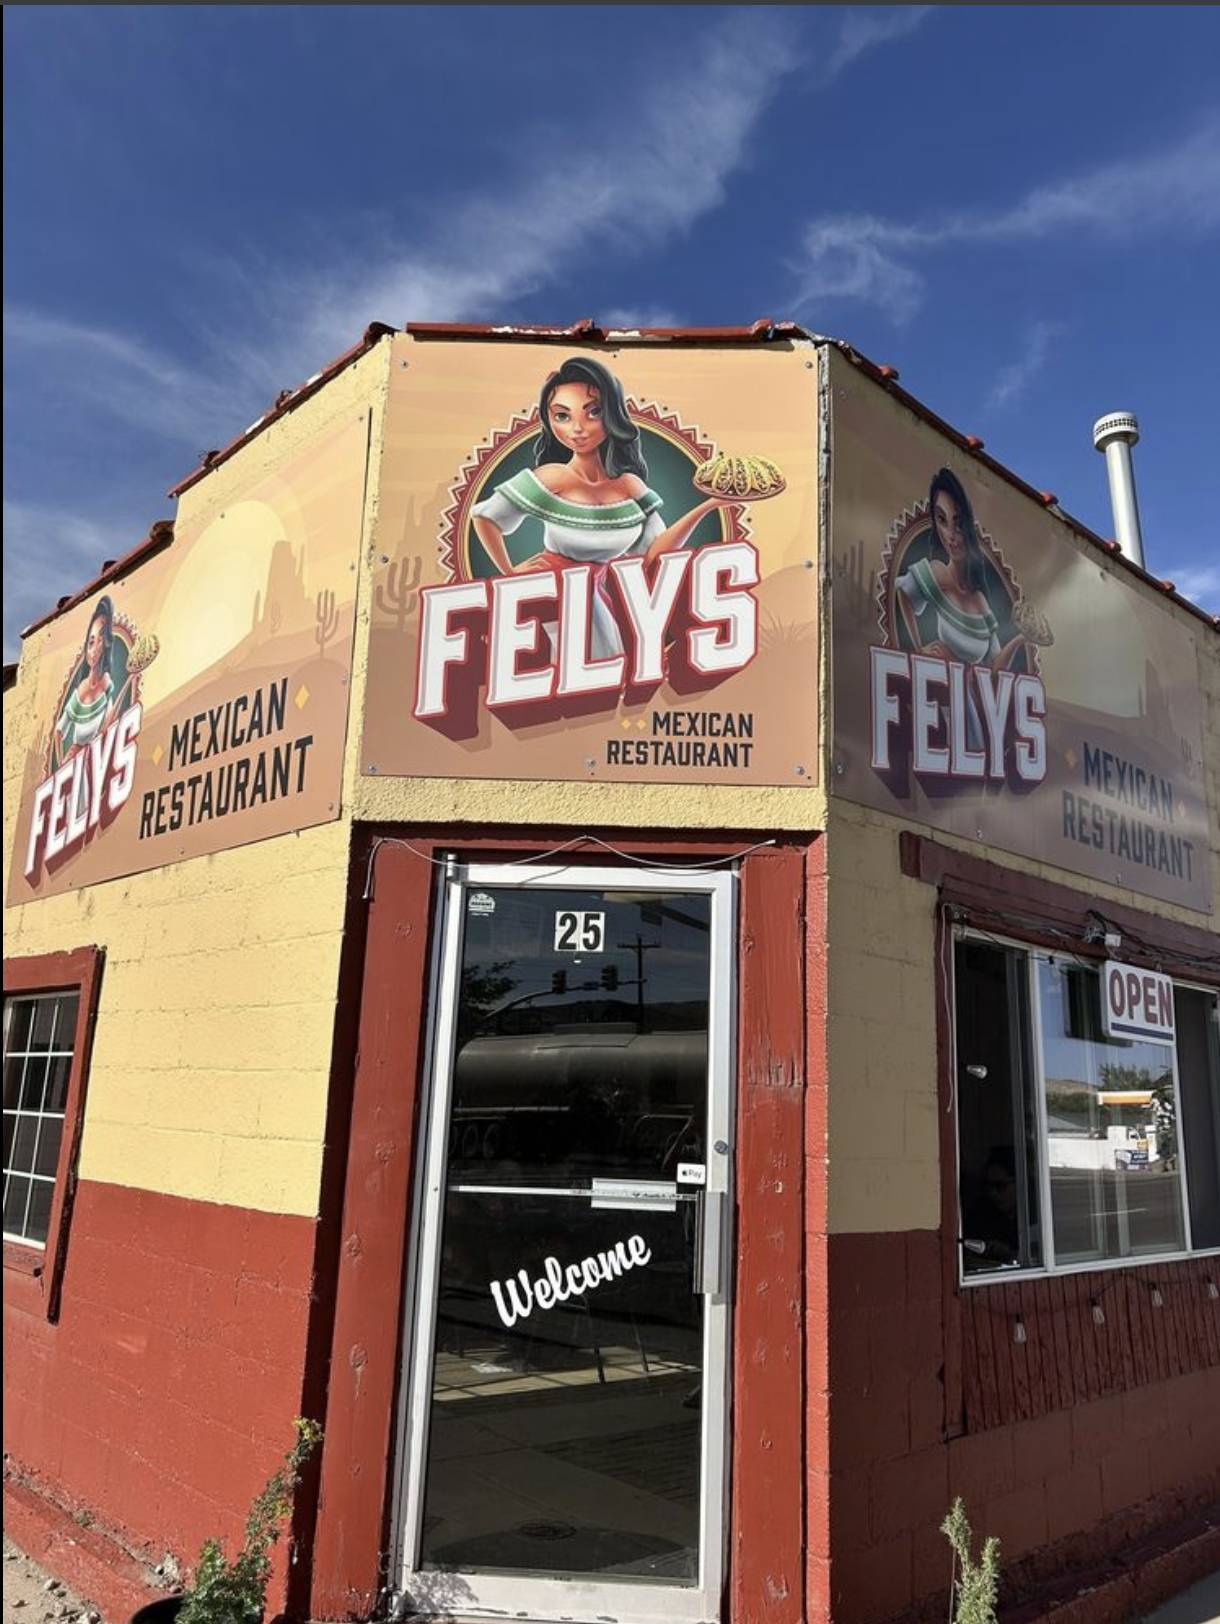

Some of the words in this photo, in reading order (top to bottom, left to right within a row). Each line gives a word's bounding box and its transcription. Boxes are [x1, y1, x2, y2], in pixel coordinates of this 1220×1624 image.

[413, 540, 759, 719] FELYS
[168, 678, 288, 771] MEXICAN
[606, 740, 753, 767] RESTAURANT
[652, 711, 753, 738] MEXICAN
[870, 646, 1047, 781] FELYS
[24, 702, 143, 878] FELYS
[139, 735, 313, 840] RESTAURANT
[1083, 741, 1173, 823] MEXICAN
[1062, 789, 1193, 882] RESTAURANT
[558, 912, 601, 950] 25
[1109, 969, 1173, 1028] OPEN
[688, 1169, 702, 1179] Pay
[490, 1235, 651, 1327] Welcome
